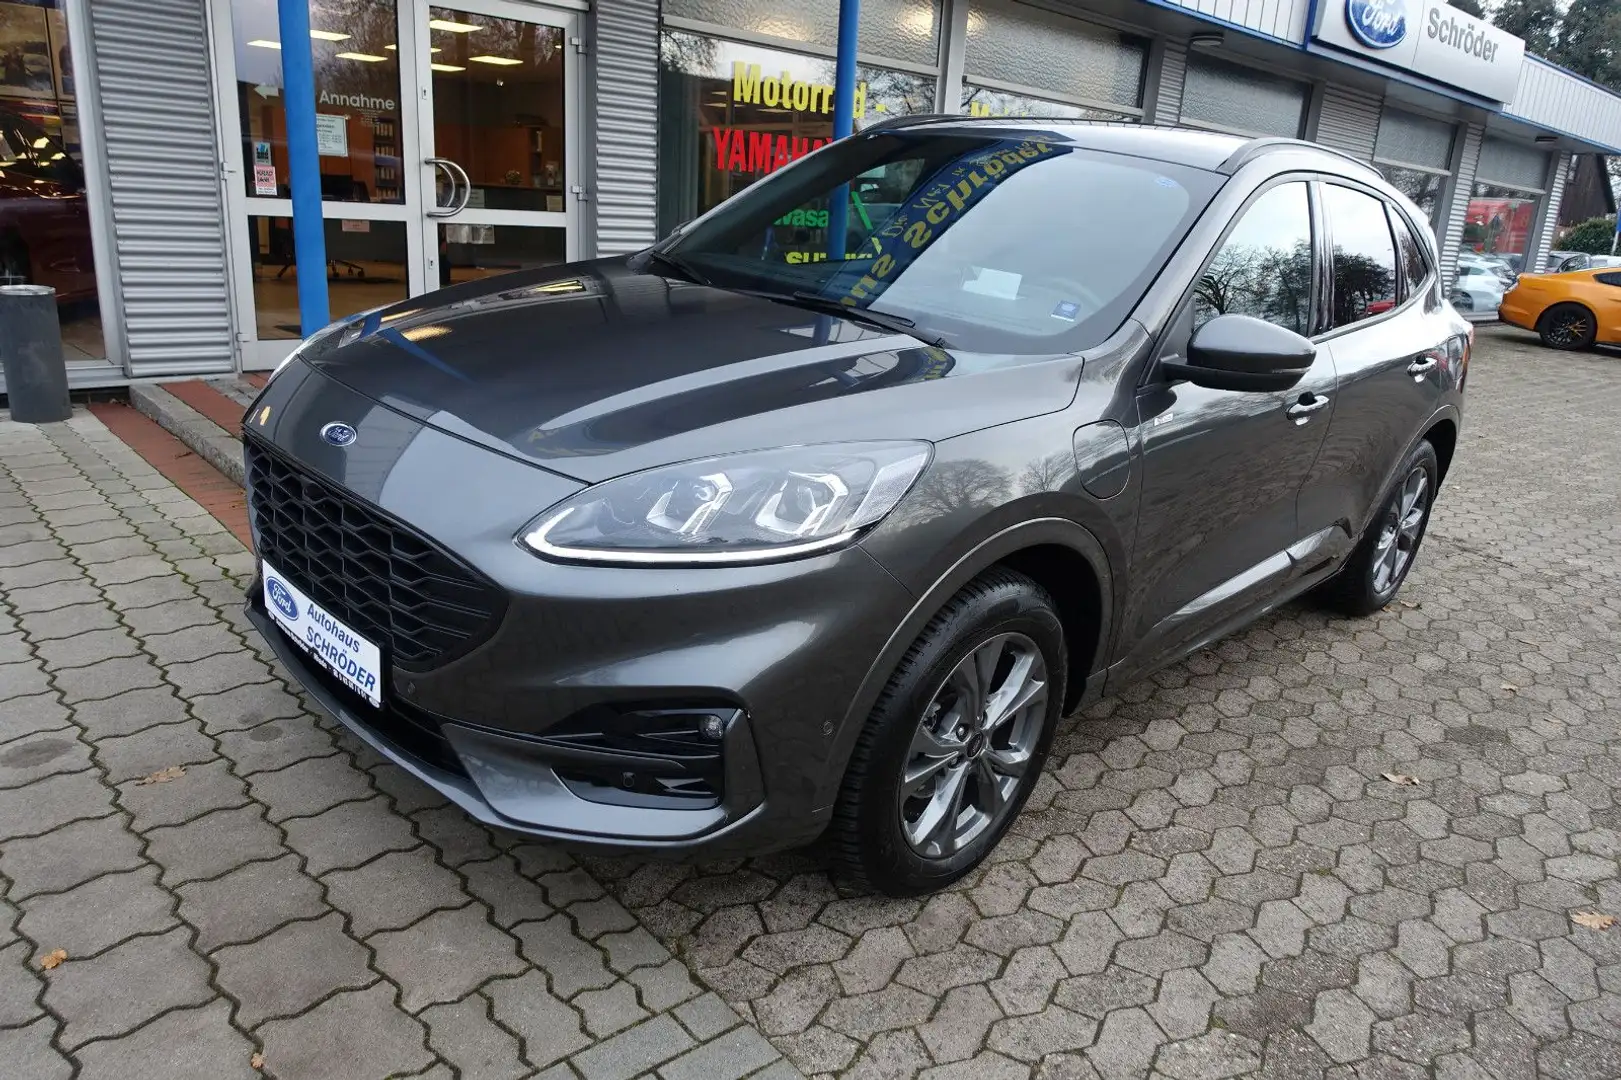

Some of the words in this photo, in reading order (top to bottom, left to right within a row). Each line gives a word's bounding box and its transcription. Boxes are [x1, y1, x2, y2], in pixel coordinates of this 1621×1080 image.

[1427, 7, 1498, 63] Schröder
[319, 89, 396, 111] Annahme
[733, 60, 867, 119] Motorrd
[272, 583, 291, 613] Ford
[307, 603, 360, 653] Autohaus
[306, 626, 376, 691] SCHRÖDER
